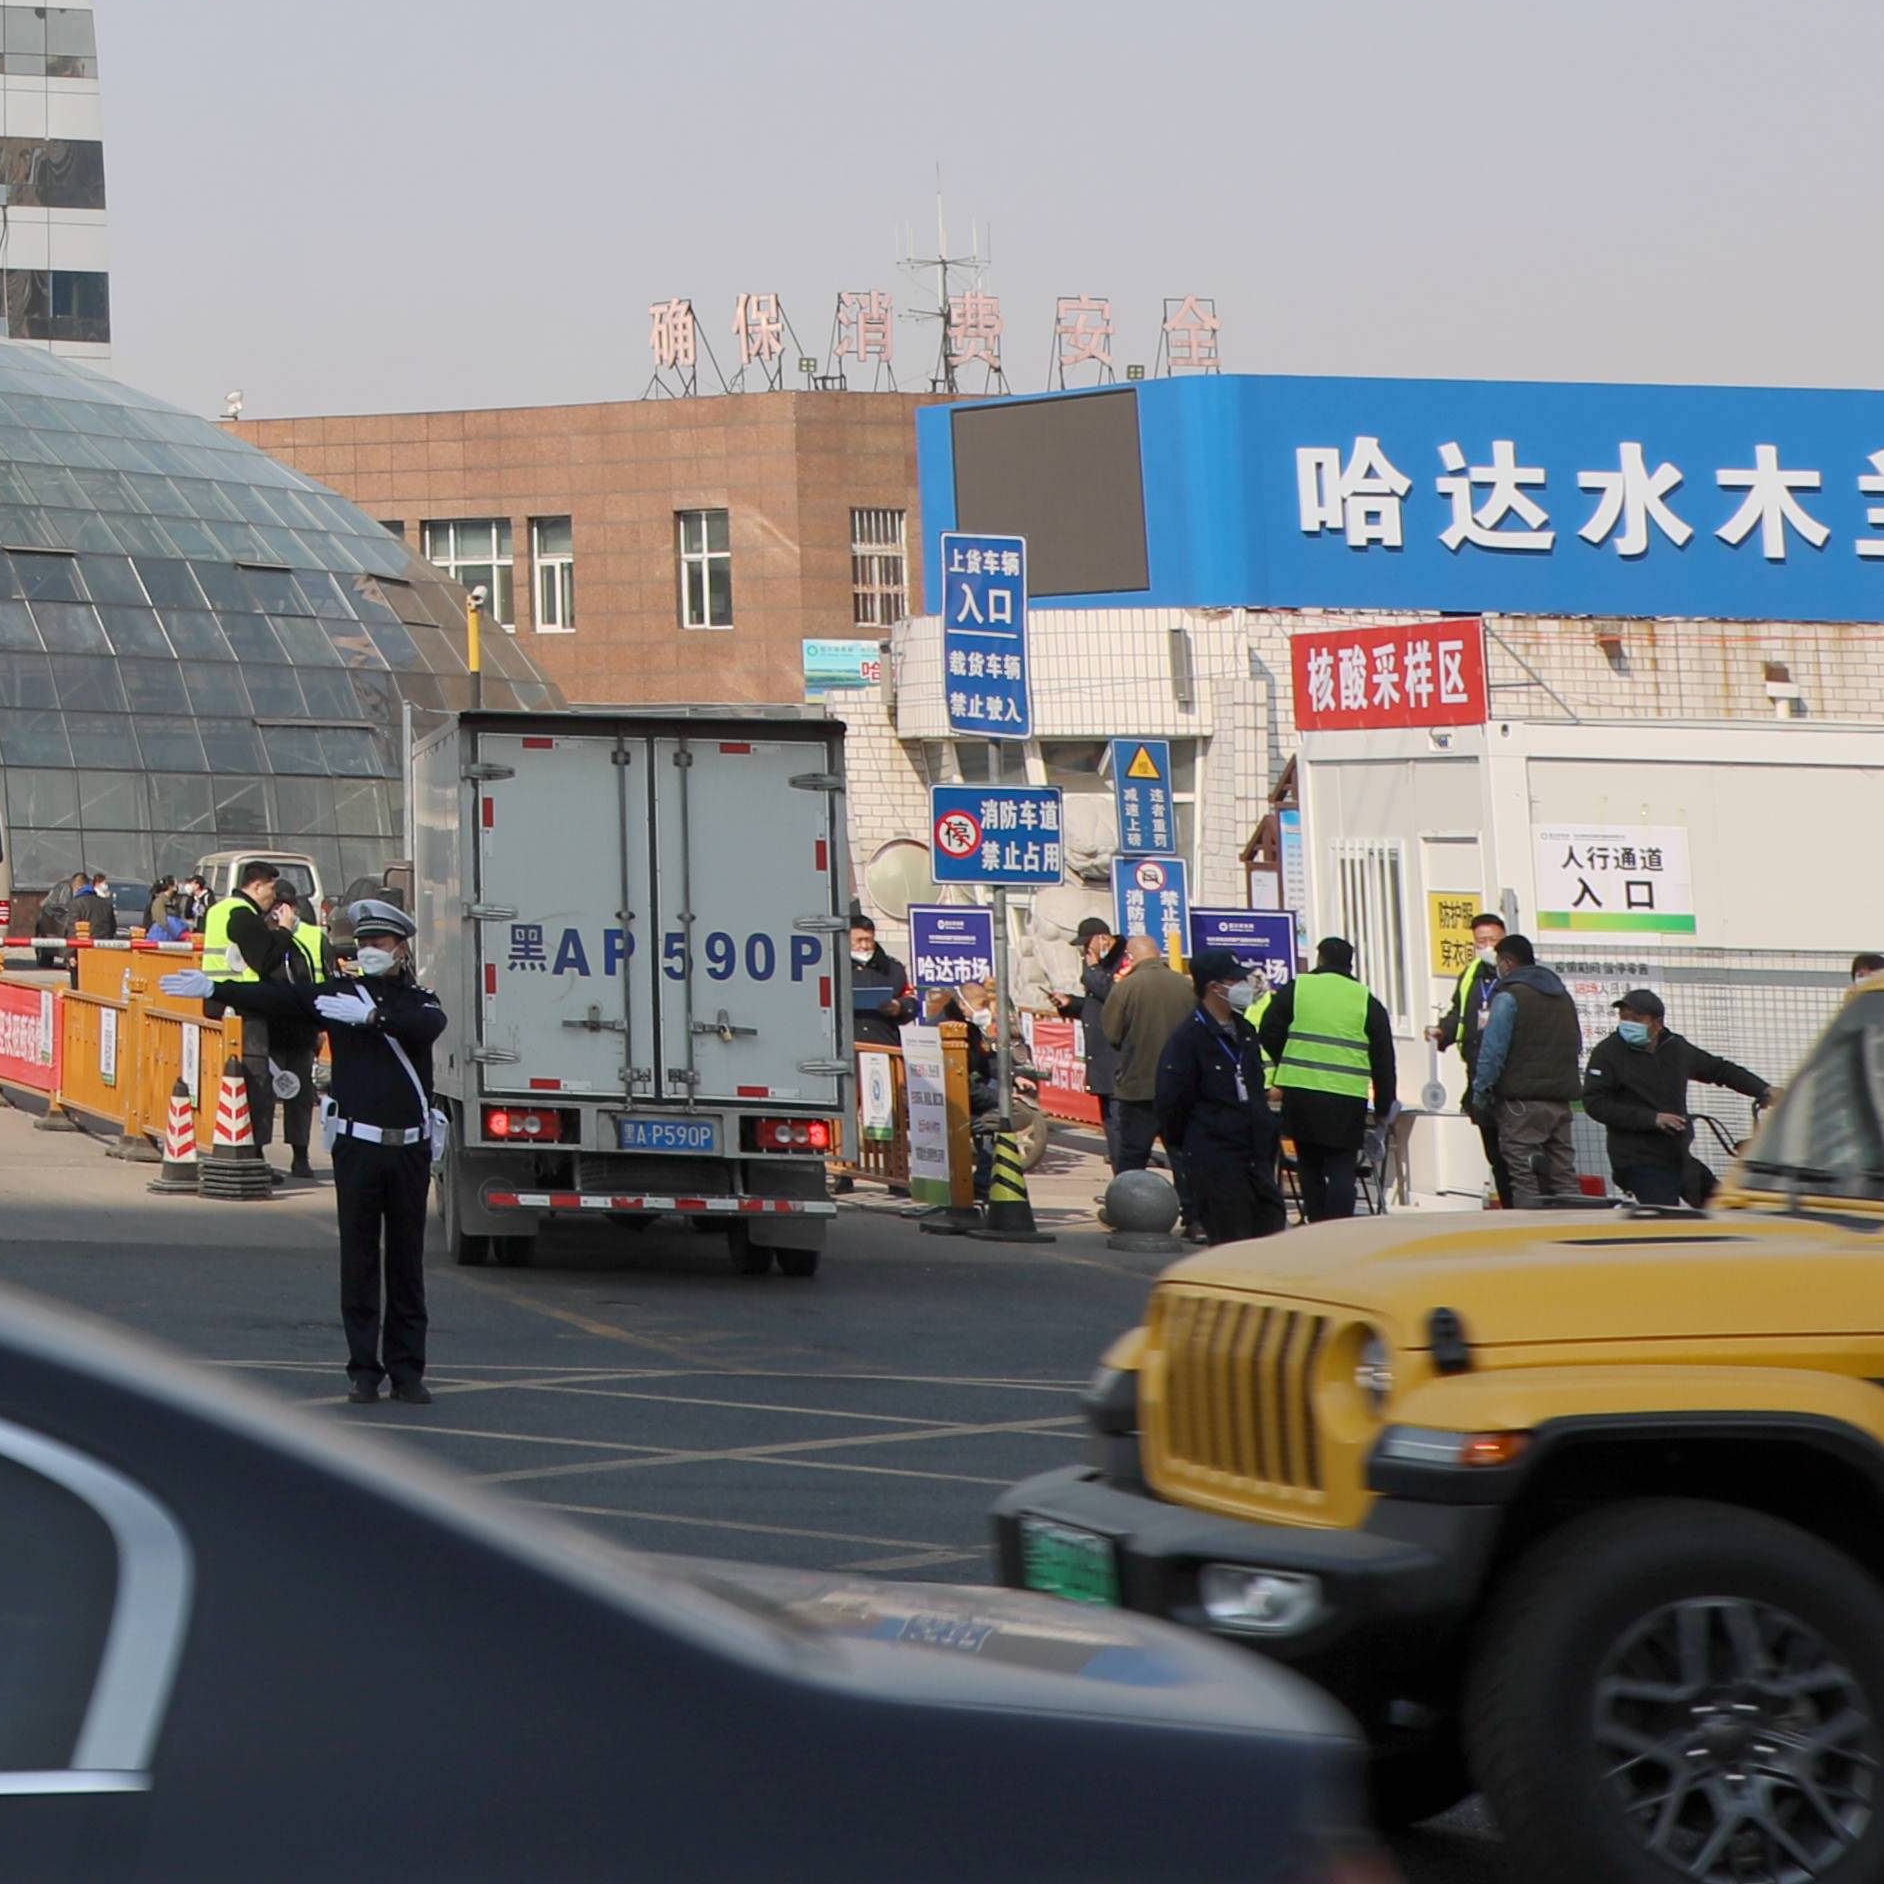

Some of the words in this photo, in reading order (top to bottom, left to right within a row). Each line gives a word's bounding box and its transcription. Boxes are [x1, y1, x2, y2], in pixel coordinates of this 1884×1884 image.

[648, 289, 1224, 369] 确保消费安全
[1295, 434, 1884, 561] 哈达水木
[948, 548, 1021, 577] 上货车辆
[956, 582, 1013, 625] 入口
[948, 649, 1023, 682] 载货车辆
[1307, 639, 1470, 713] 核酸采样区
[949, 691, 1023, 724] 禁止驶入
[980, 799, 1060, 832] 消防车道
[981, 840, 1061, 873] 禁止占用
[1561, 844, 1665, 872] 人行通道
[1571, 876, 1655, 910] 入口
[1125, 889, 1147, 937] 消防通
[1159, 890, 1180, 951] 禁止停
[917, 955, 991, 984] 哈达市场
